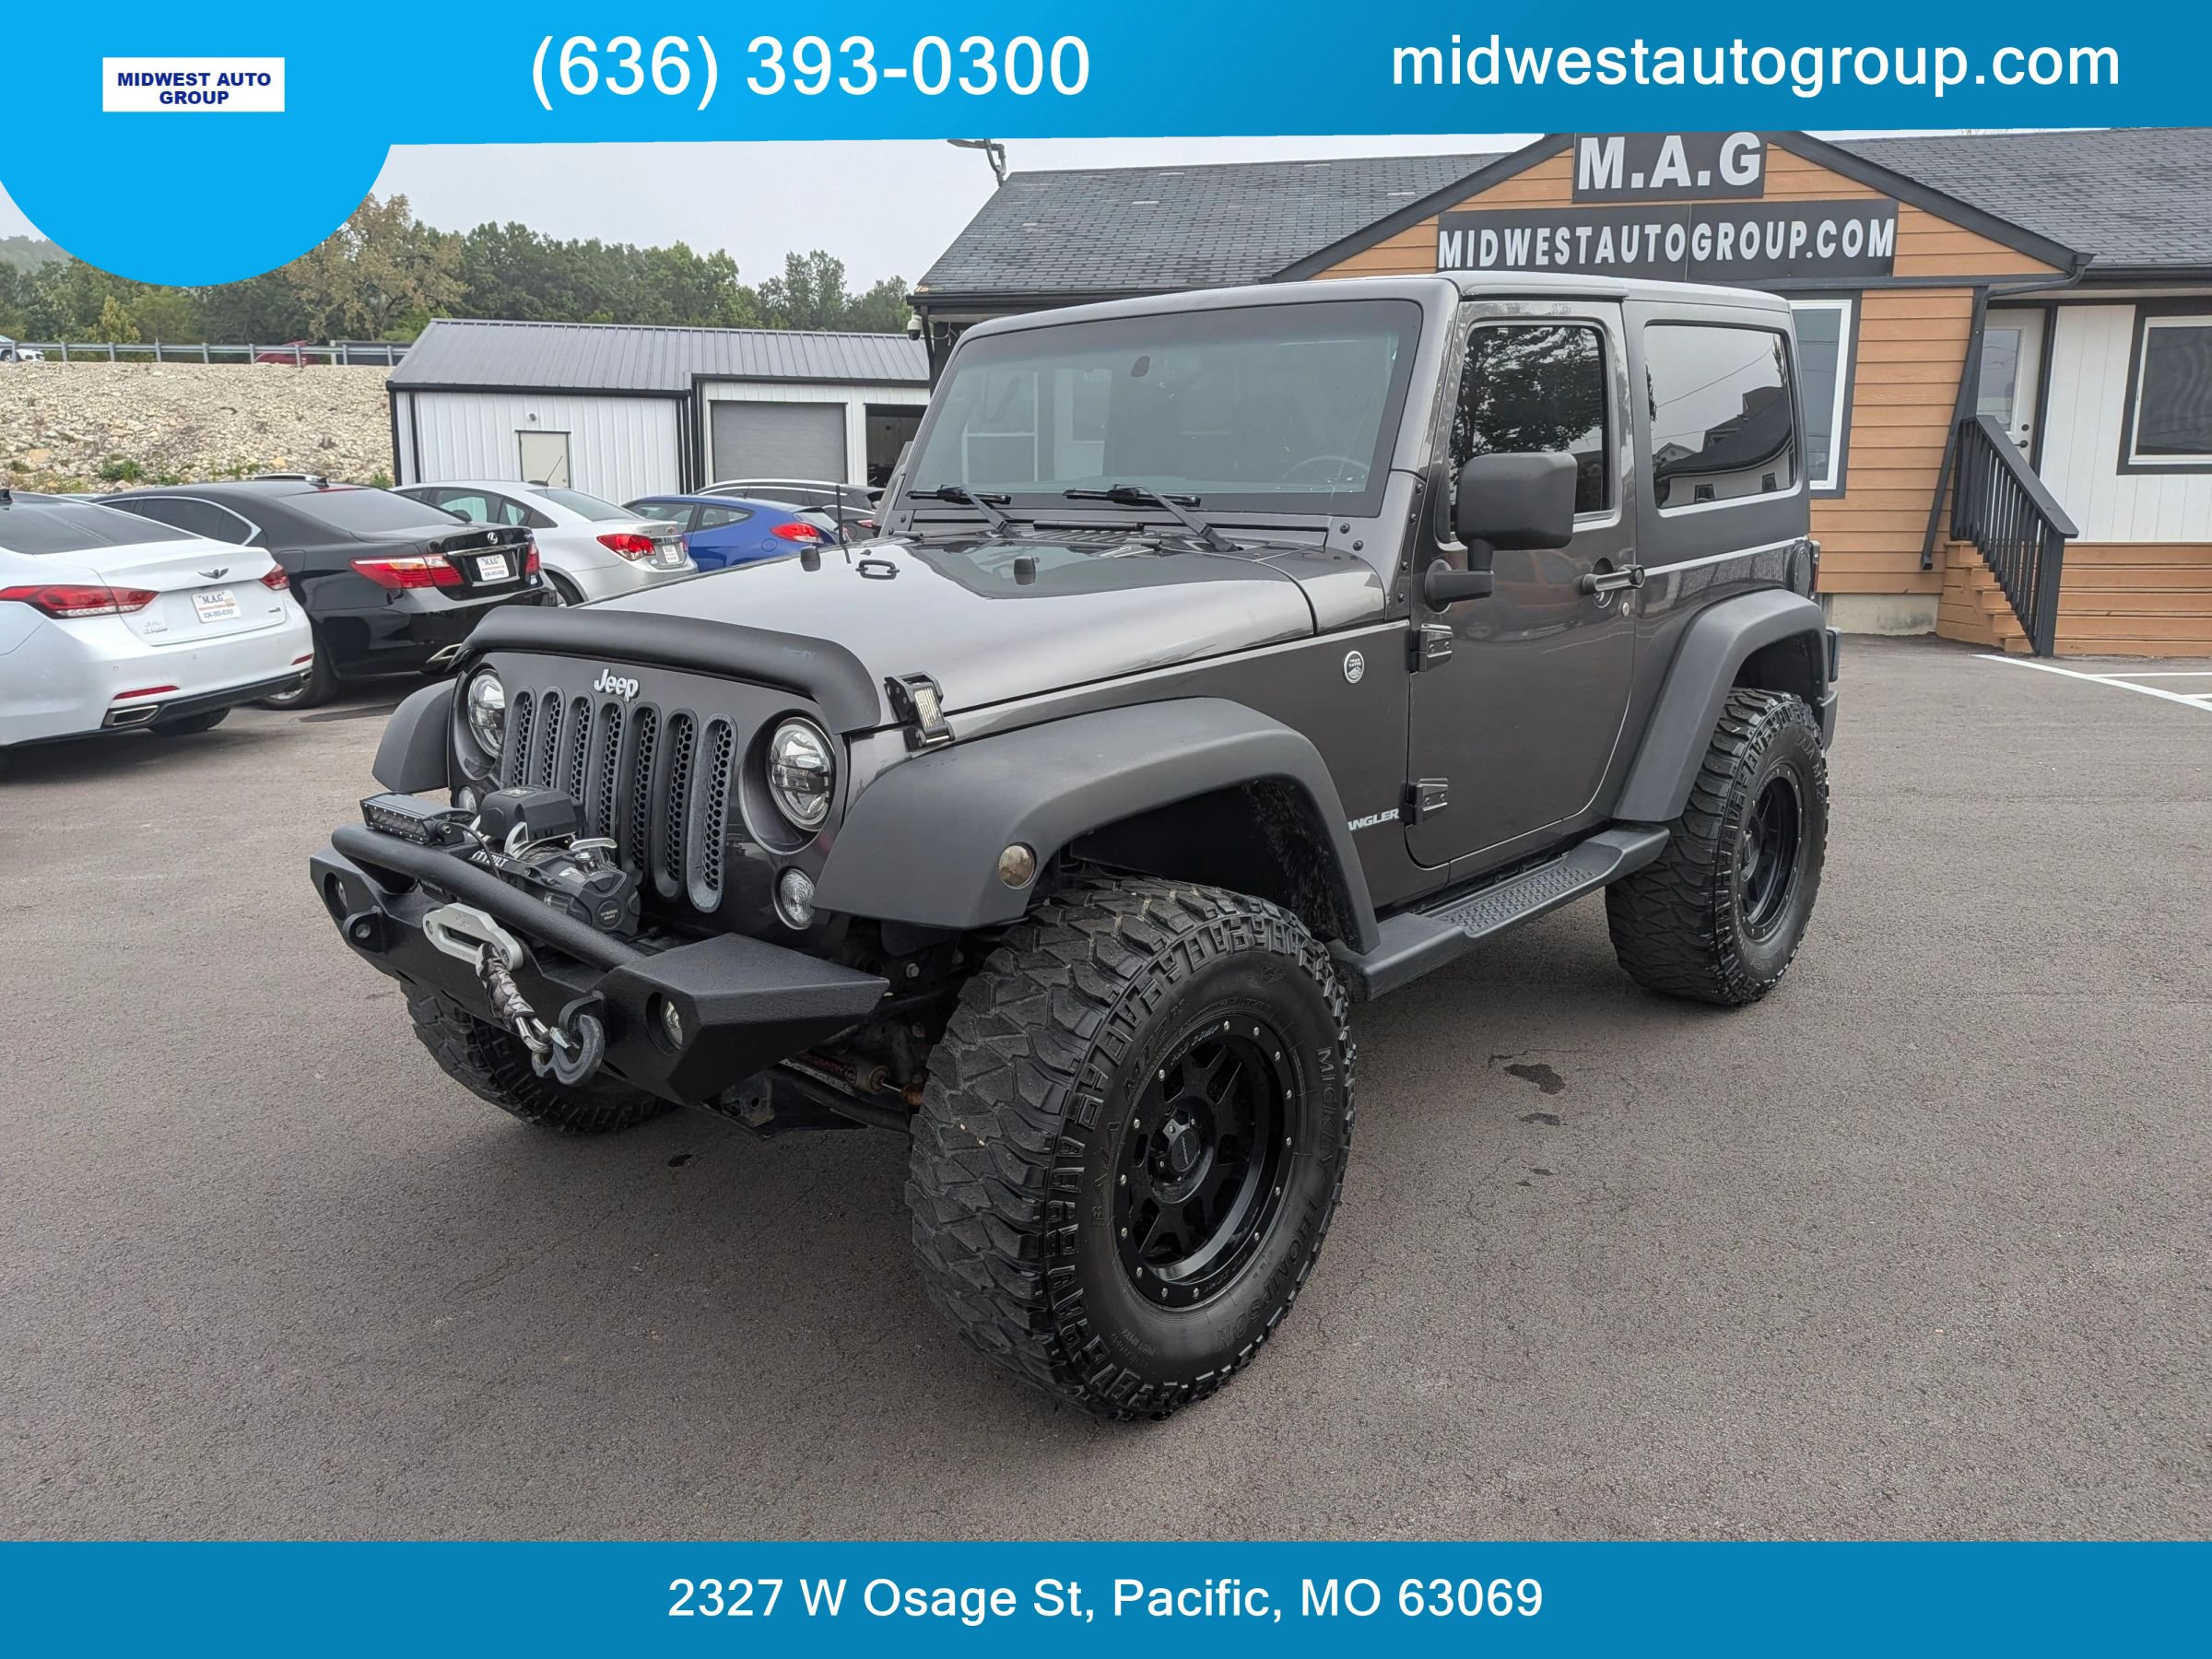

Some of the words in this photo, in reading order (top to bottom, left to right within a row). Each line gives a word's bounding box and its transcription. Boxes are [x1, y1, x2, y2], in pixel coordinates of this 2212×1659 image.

[1577, 131, 1762, 191] M.A.G
[1437, 218, 1895, 269] MIDWESTAUTOGROUP.COM
[594, 669, 639, 702] Jeep
[1316, 1046, 1337, 1182] MICKEY
